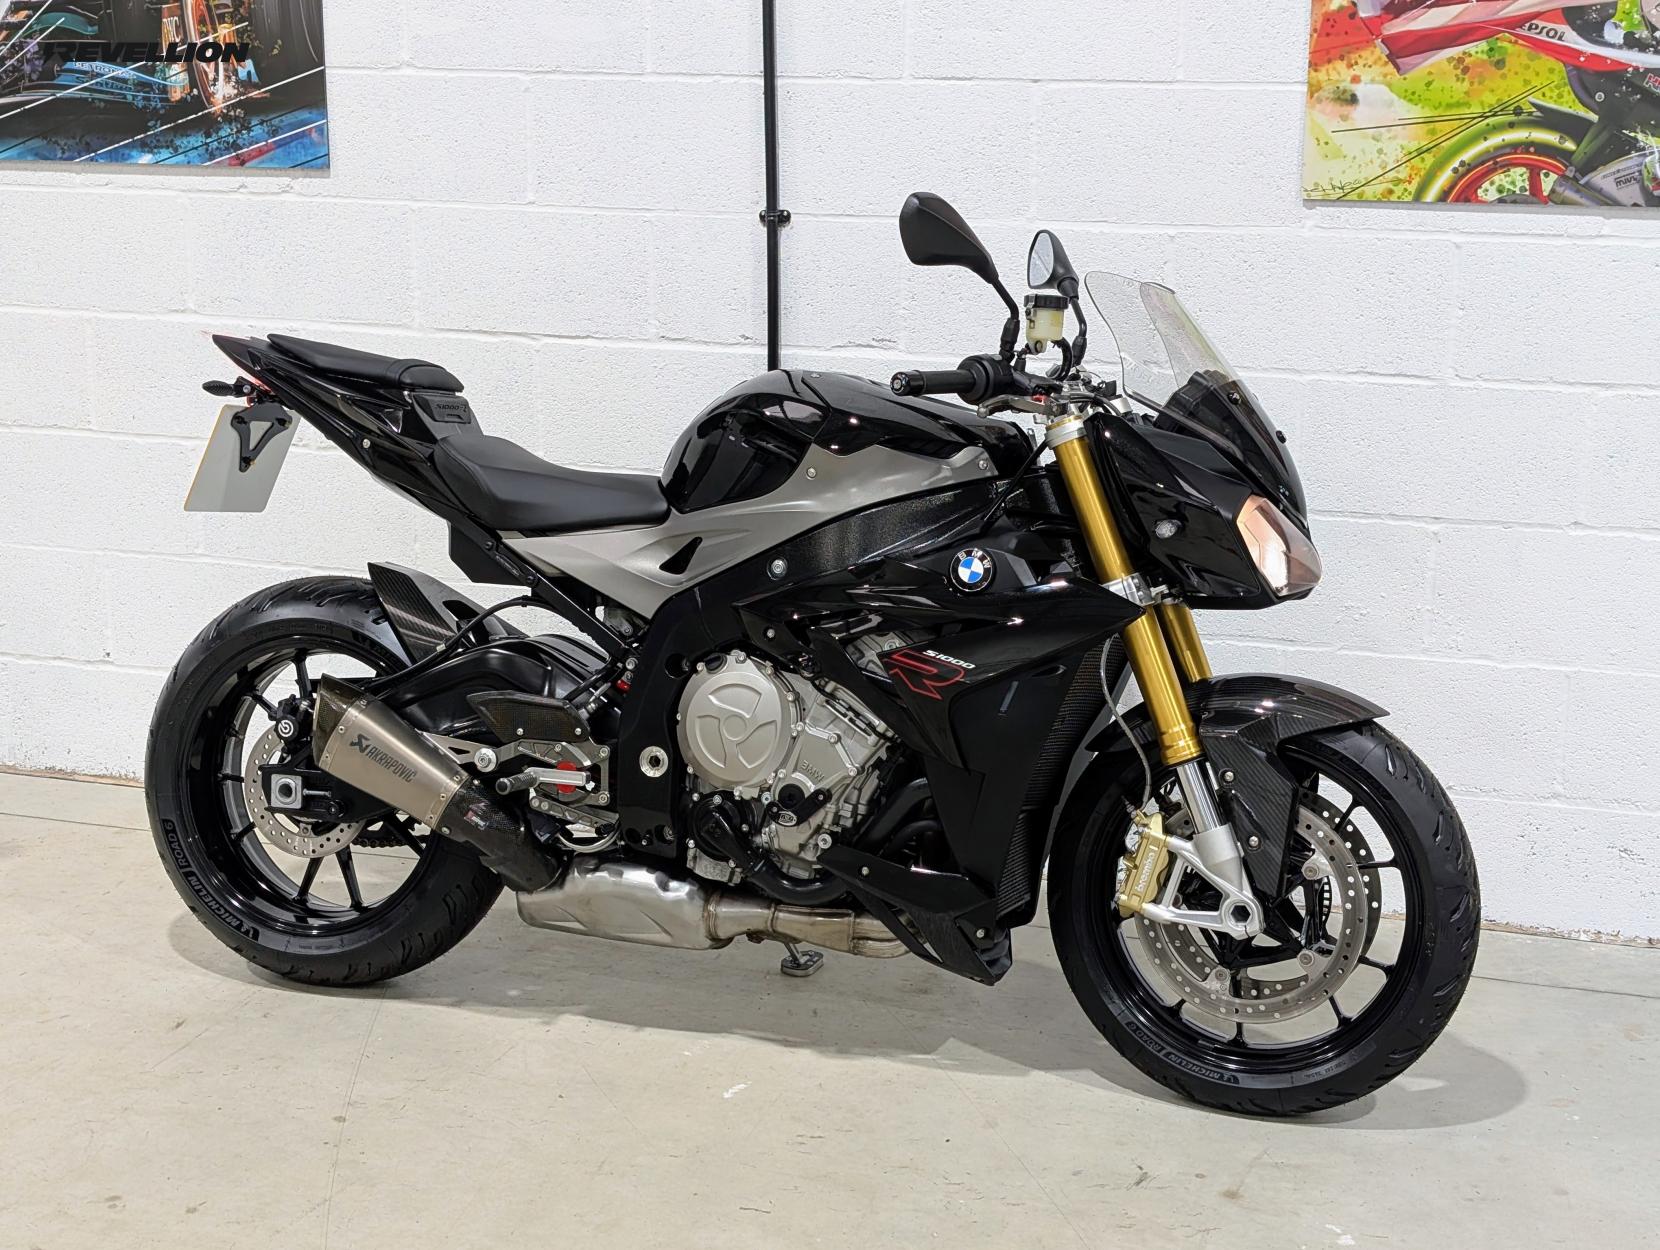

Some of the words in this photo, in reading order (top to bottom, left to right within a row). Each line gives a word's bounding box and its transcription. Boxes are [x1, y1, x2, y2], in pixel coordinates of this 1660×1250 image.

[923, 649, 976, 669] S1000
[801, 759, 825, 782] BMW
[168, 833, 190, 868] ROAD
[1135, 852, 1156, 892] brembo
[187, 876, 241, 928] MICHELIN
[1136, 1029, 1162, 1053] ROAD
[1168, 1054, 1221, 1078] MICHELIN
